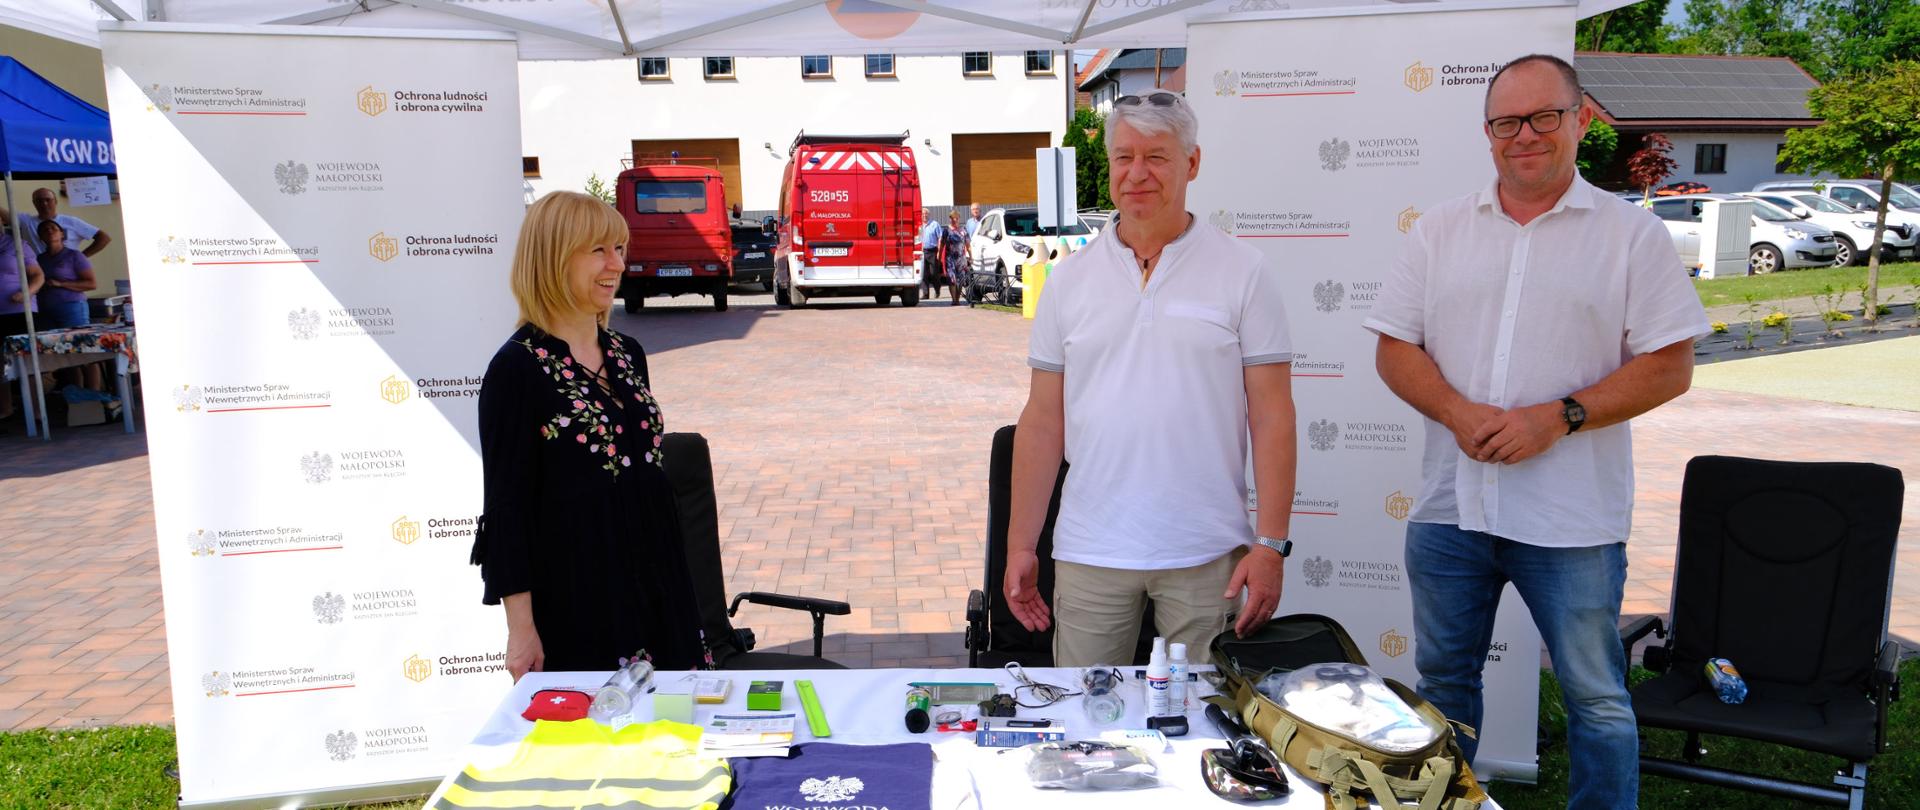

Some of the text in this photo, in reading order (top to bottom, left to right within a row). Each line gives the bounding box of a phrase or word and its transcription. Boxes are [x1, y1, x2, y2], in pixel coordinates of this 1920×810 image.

[1293, 70, 1318, 78] Spraw
[1442, 64, 1488, 74] Ochrona
[1240, 81, 1300, 90] Wewnętrznych
[1304, 78, 1356, 88] Administracji
[1447, 76, 1486, 85] obrona
[174, 87, 263, 97] Ministerstwo Spraw
[394, 91, 488, 101] Ochrona ludności
[175, 97, 243, 107] Wewnętrznych
[249, 98, 306, 108] Administracji
[401, 103, 440, 112] obrona
[441, 103, 483, 113] cywilna
[1358, 138, 1418, 148] WOJEWODA
[45, 137, 93, 165] KGW
[1356, 149, 1420, 158] MAŁOPOLSKI
[316, 162, 380, 172] WOJEWODA
[315, 173, 383, 182] MAŁOPOLSKI
[1236, 212, 1312, 221] Ministerstwo Spraw
[1236, 222, 1293, 230] Wewnętrznych
[1299, 221, 1350, 230] Administracji
[189, 237, 276, 247] Ministerstwo Spraw
[406, 234, 498, 245] Ochrona ludności
[190, 248, 257, 257] Wewnętrznych
[263, 246, 319, 256] Administracji
[412, 247, 450, 257] obrona
[452, 245, 493, 257] cywilna
[328, 307, 392, 317] WOJEWODA
[328, 318, 394, 328] MAŁOPOLSKI
[1294, 361, 1344, 371] Administracji
[417, 375, 483, 387] Ochrona lud
[204, 383, 290, 394] Ministerstwo Spraw
[424, 389, 461, 398] obrona
[205, 393, 271, 404] Wewnętrznych
[276, 391, 331, 401] Administracji
[1346, 422, 1406, 432] WOJEWODA
[1344, 434, 1406, 443] MAŁOPOLSKI
[341, 450, 403, 460] WOJEWODA
[340, 460, 405, 471] MAŁOPOLSKI
[1293, 498, 1338, 509] dministracji
[428, 518, 473, 528] Ochrona
[218, 526, 302, 538] Ministerstwo Spraw
[434, 528, 471, 538] obrona
[219, 536, 284, 548] Wewnętrznych
[289, 534, 343, 544] Administracji
[1341, 560, 1398, 571] WOJEWODA
[1339, 571, 1400, 582] MAŁOPOLSKI
[353, 589, 414, 600] WOJEWODA
[352, 600, 416, 611] MAŁOPOLSKI
[439, 655, 484, 665] Ochrona
[232, 666, 314, 679] Ministerstwo Spraw
[445, 665, 482, 676] obrona
[233, 676, 296, 689] Wewnętrznych
[301, 672, 355, 683] Administracji
[365, 726, 426, 737] WOJEWODA
[364, 735, 428, 748] MAŁOPOLSKI
